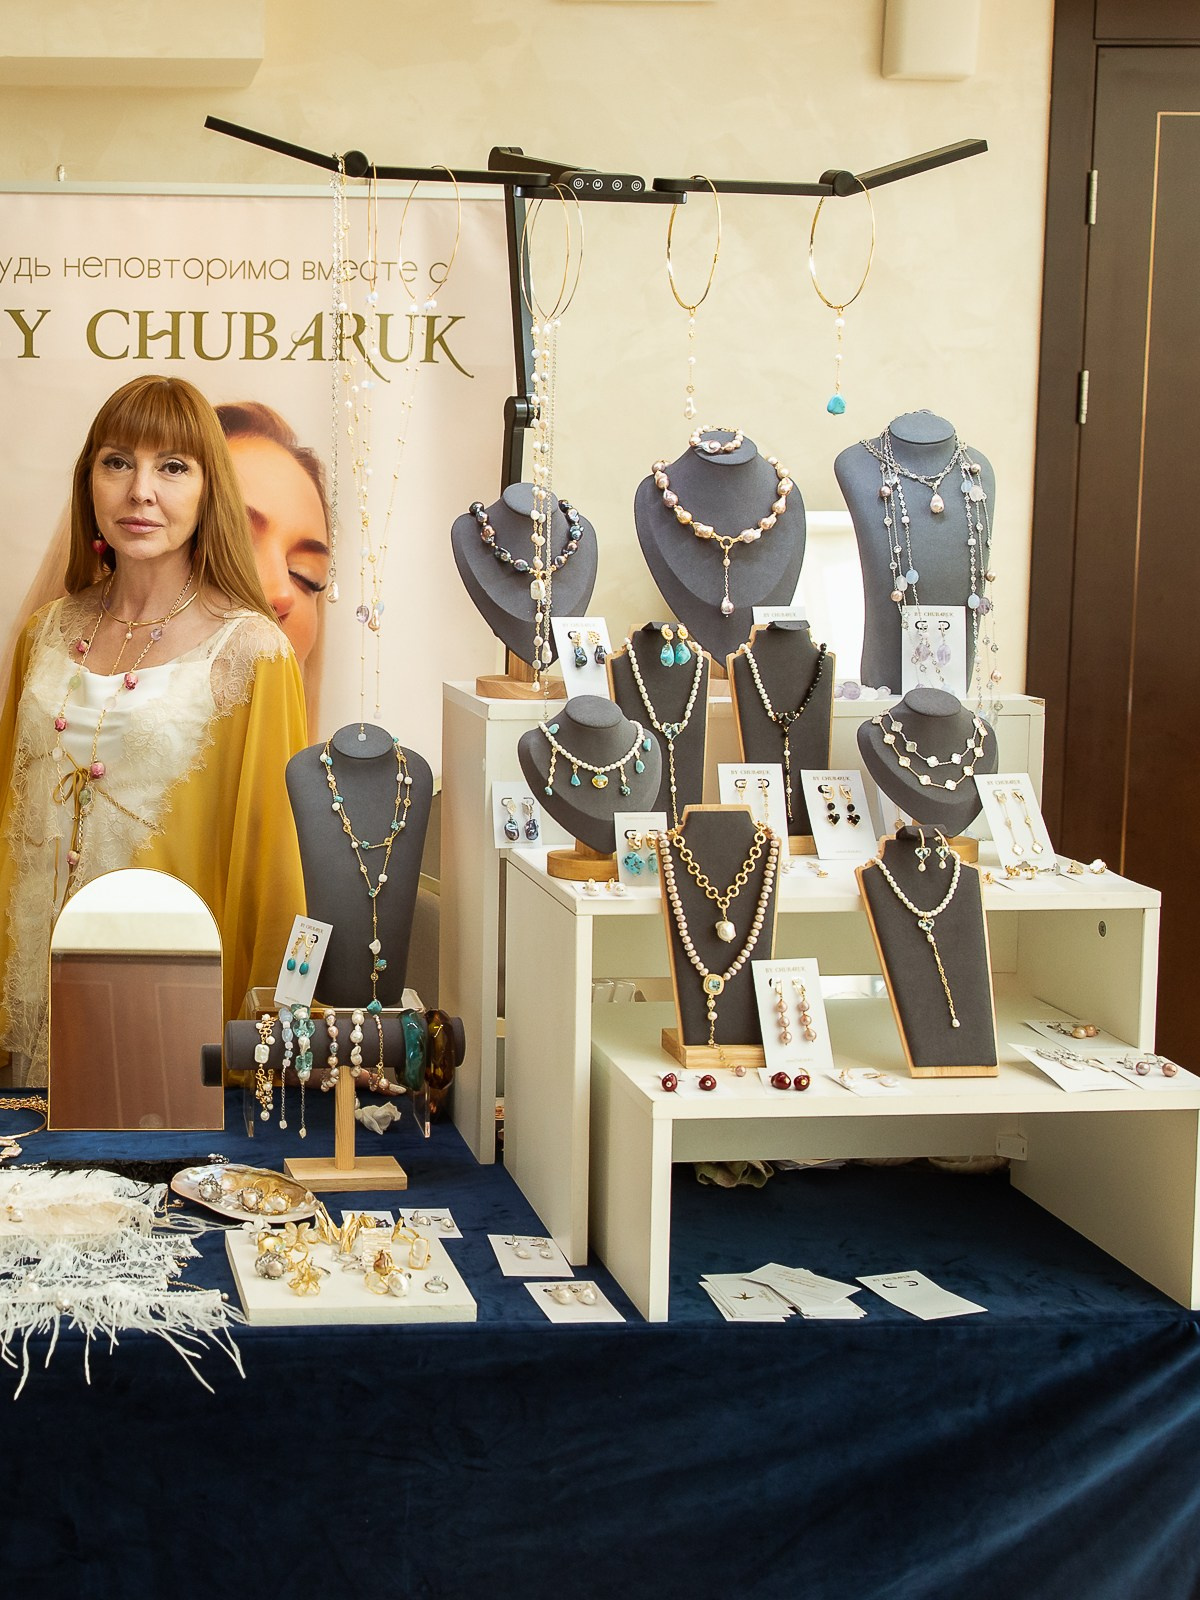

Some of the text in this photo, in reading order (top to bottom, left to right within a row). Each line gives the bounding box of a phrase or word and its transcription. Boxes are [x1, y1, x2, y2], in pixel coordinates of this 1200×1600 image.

[63, 256, 290, 287] неповторима
[302, 260, 418, 283] вместе
[85, 307, 475, 384] CHUBARUK
